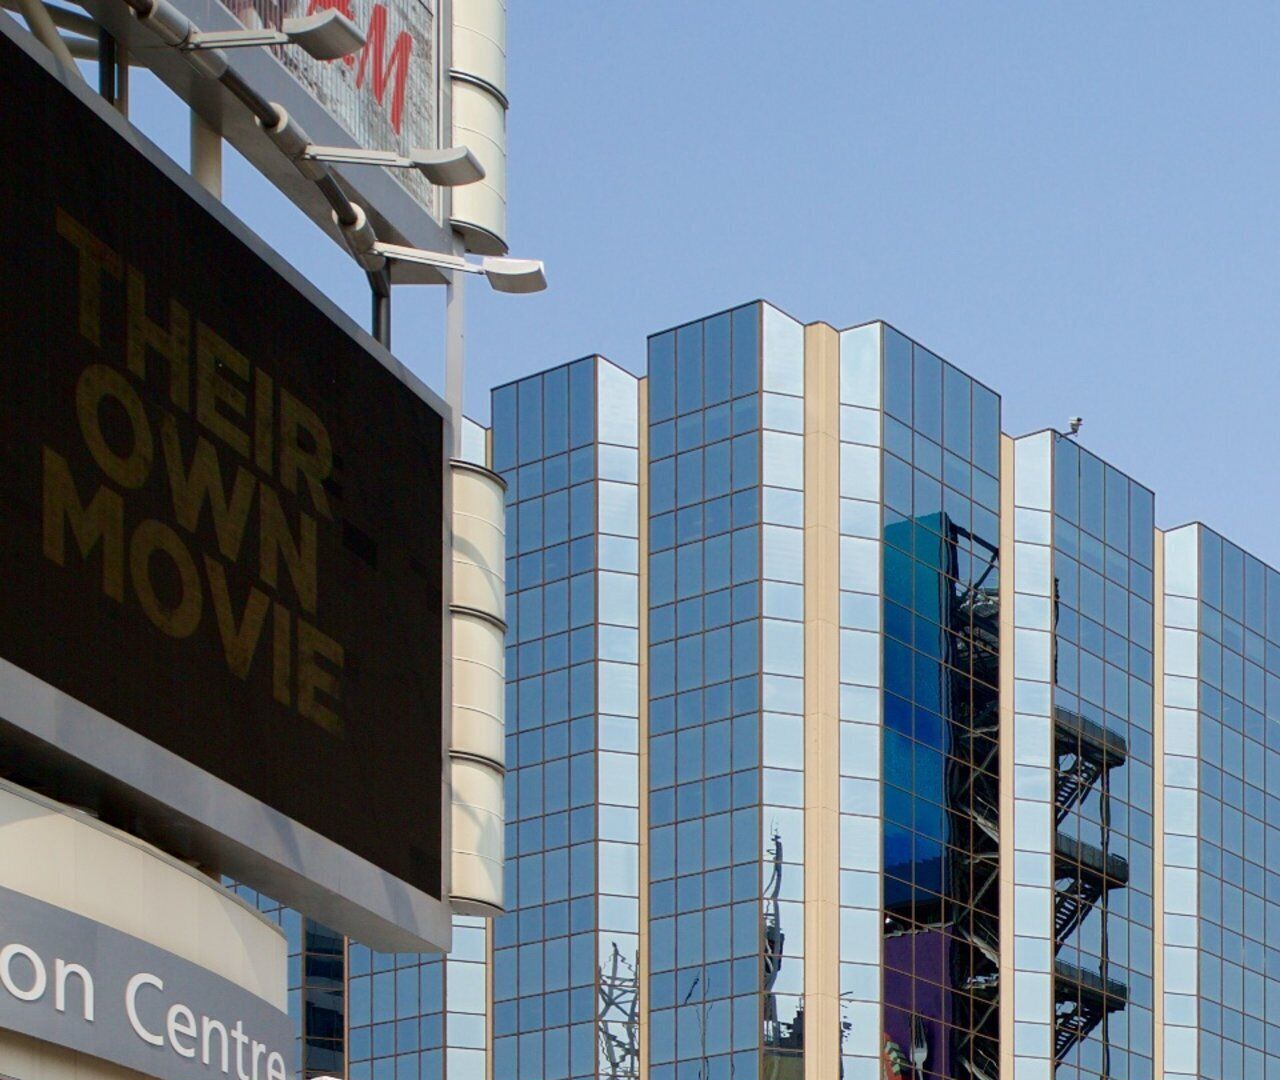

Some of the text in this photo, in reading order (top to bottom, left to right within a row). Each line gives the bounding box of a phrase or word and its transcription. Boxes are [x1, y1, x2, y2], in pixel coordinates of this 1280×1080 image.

[56, 207, 335, 518] THEIR
[76, 364, 319, 612] OWN
[42, 442, 346, 738] MOVIE
